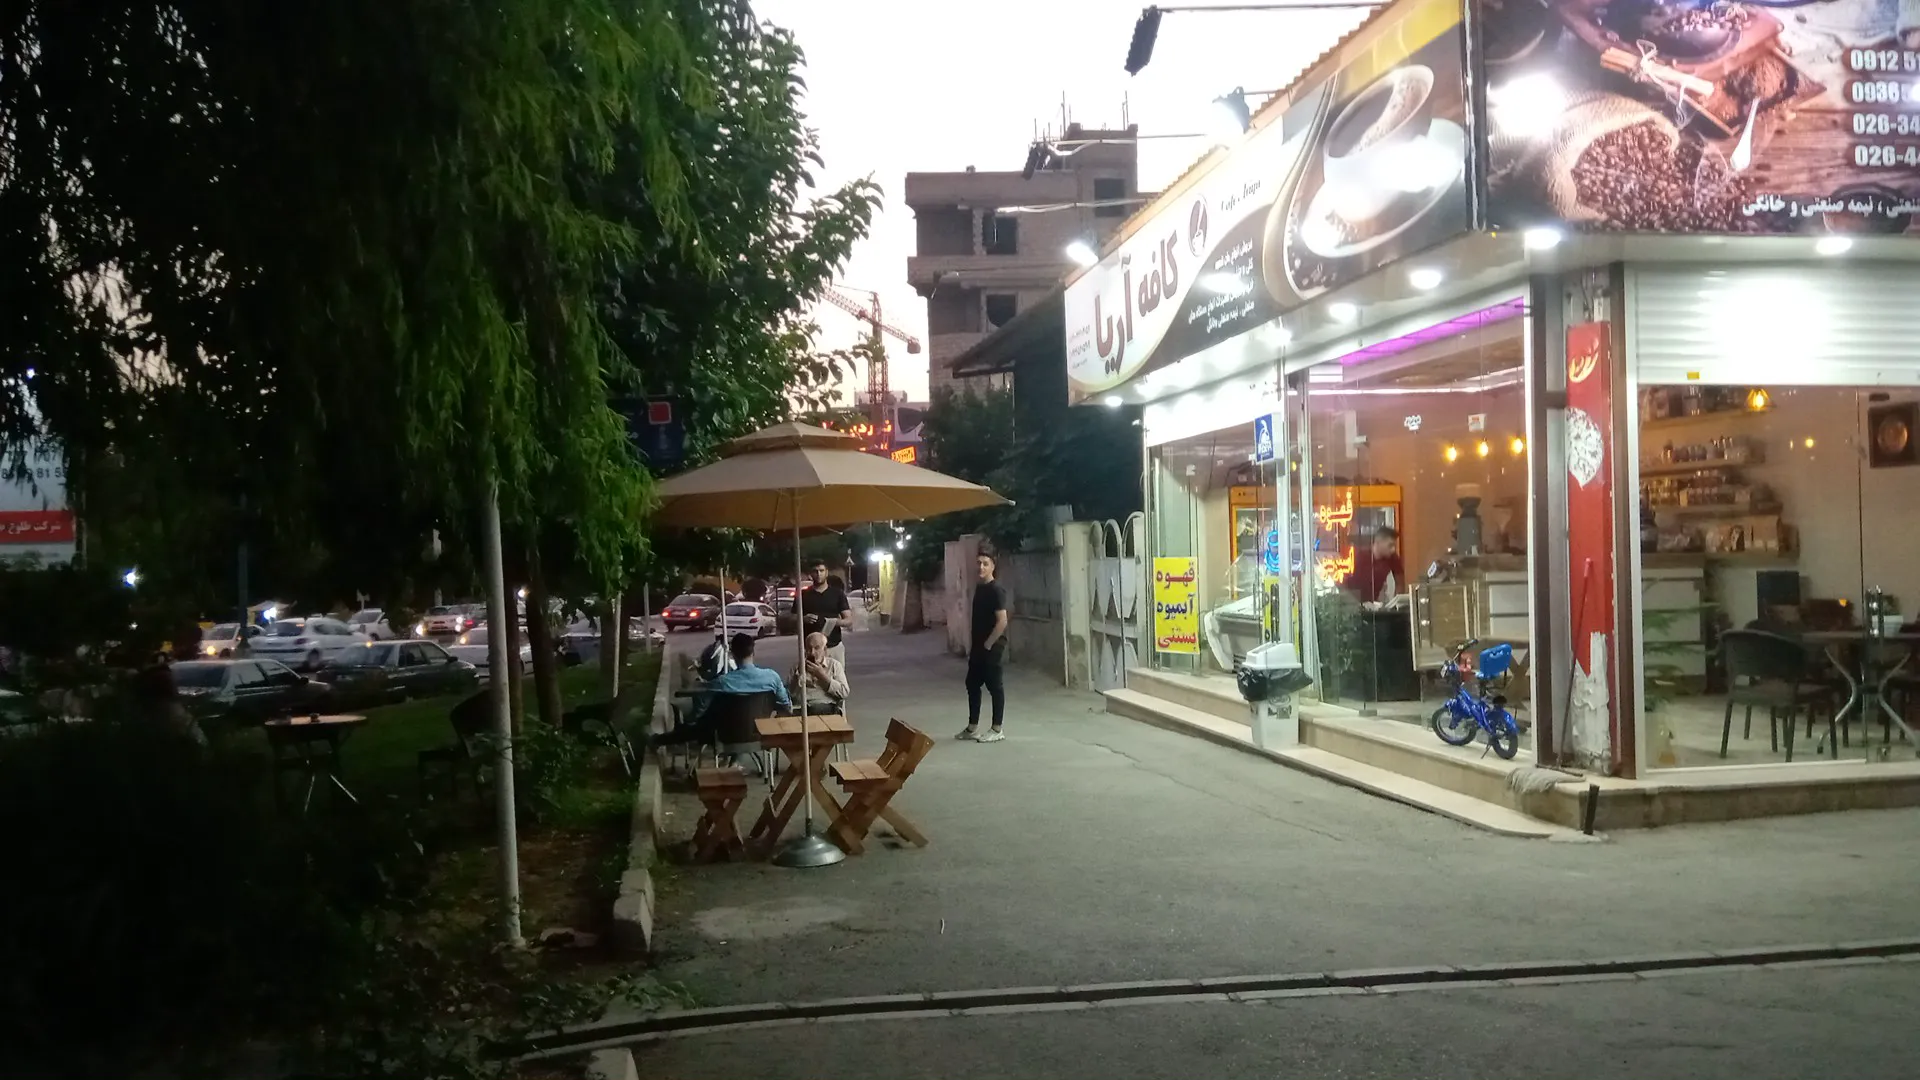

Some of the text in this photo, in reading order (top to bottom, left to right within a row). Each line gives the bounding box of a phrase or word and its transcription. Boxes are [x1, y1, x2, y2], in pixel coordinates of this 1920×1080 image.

[1850, 49, 1899, 71] 0912
[1852, 80, 1900, 103] 0936
[1853, 112, 1920, 136] 026-34
[1854, 145, 1920, 167] 026-4
[1742, 194, 1786, 217] خانگی
[1789, 201, 1798, 218] و
[1801, 196, 1845, 217] صنعتی
[1848, 195, 1874, 217] نیمه
[1886, 198, 1920, 218] نعتی
[1094, 229, 1178, 375] کافه آریا
[1318, 490, 1354, 531] قهوه
[1156, 560, 1195, 588] قهوه
[1156, 593, 1194, 620] آبمیوه
[1157, 627, 1197, 651] بستنی
